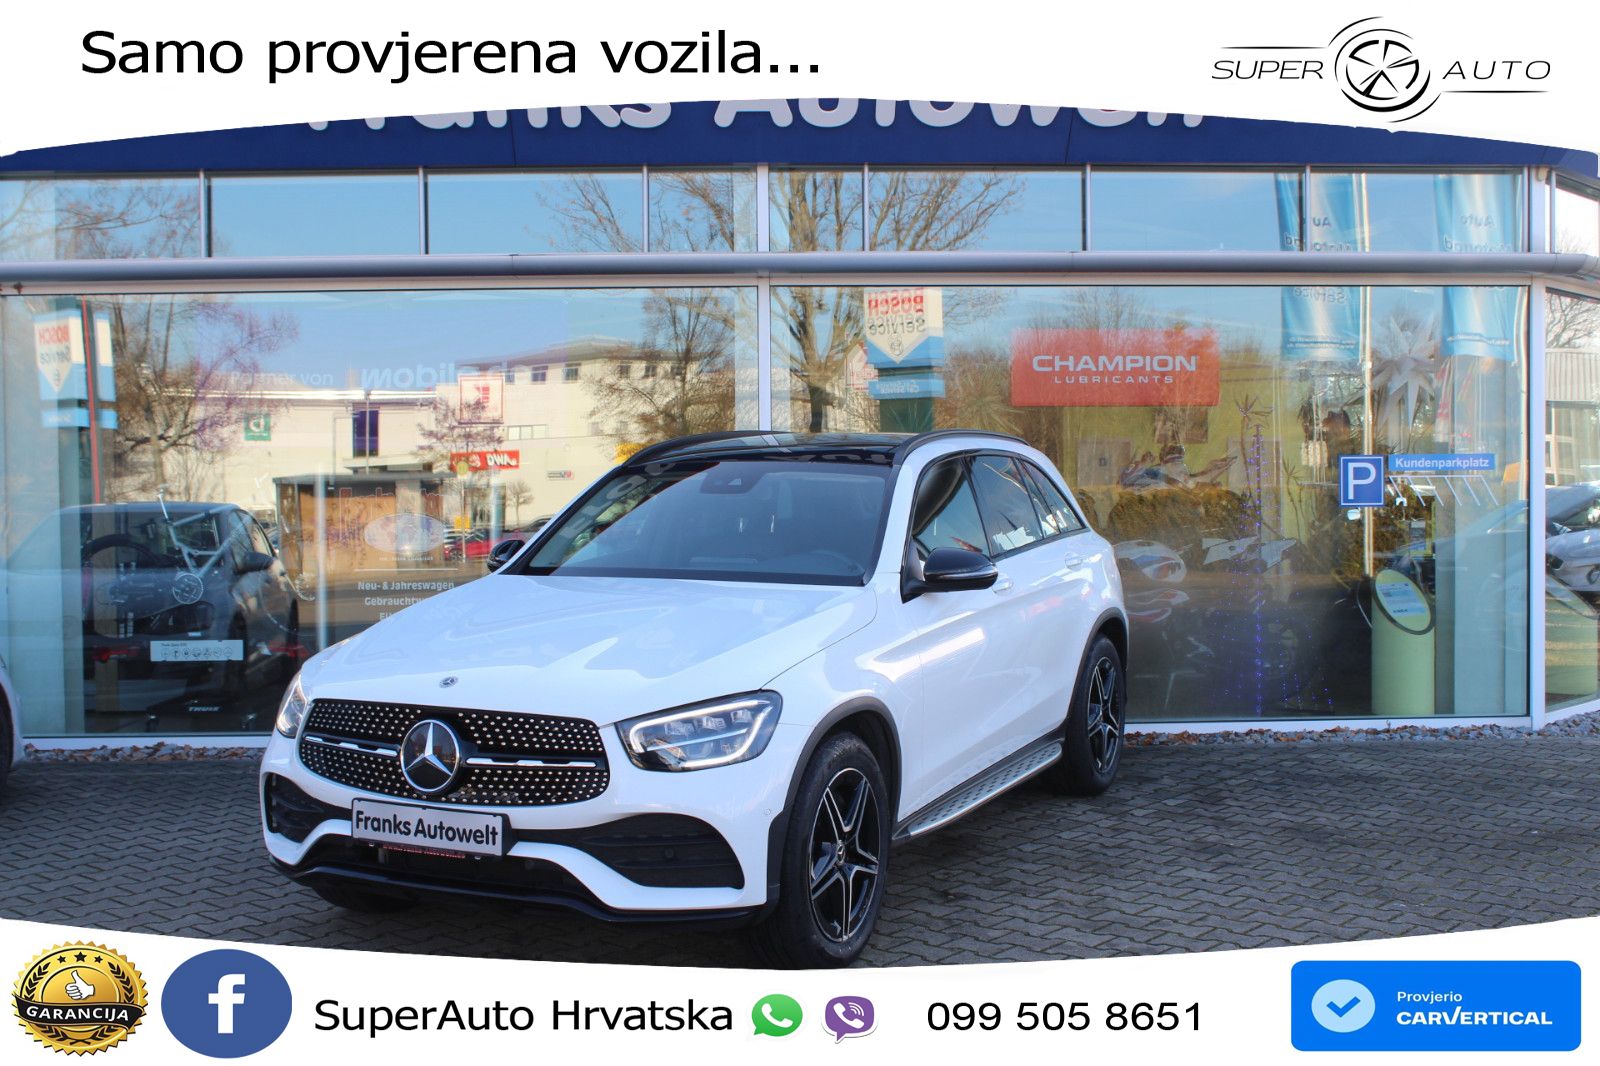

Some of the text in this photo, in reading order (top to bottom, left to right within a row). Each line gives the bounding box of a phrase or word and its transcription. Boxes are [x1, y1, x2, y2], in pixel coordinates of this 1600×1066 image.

[1032, 355, 1196, 372] CHAMPION
[301, 374, 334, 386] von
[1054, 375, 1173, 385] LUBRICANTS
[1395, 457, 1490, 469] Kundenparkplatz
[1347, 462, 1377, 500] P
[358, 581, 381, 591] Neu-
[391, 581, 455, 592] Jahreswagen
[364, 597, 424, 607] Gebraucht
[355, 810, 499, 846] Franks Autowelt
